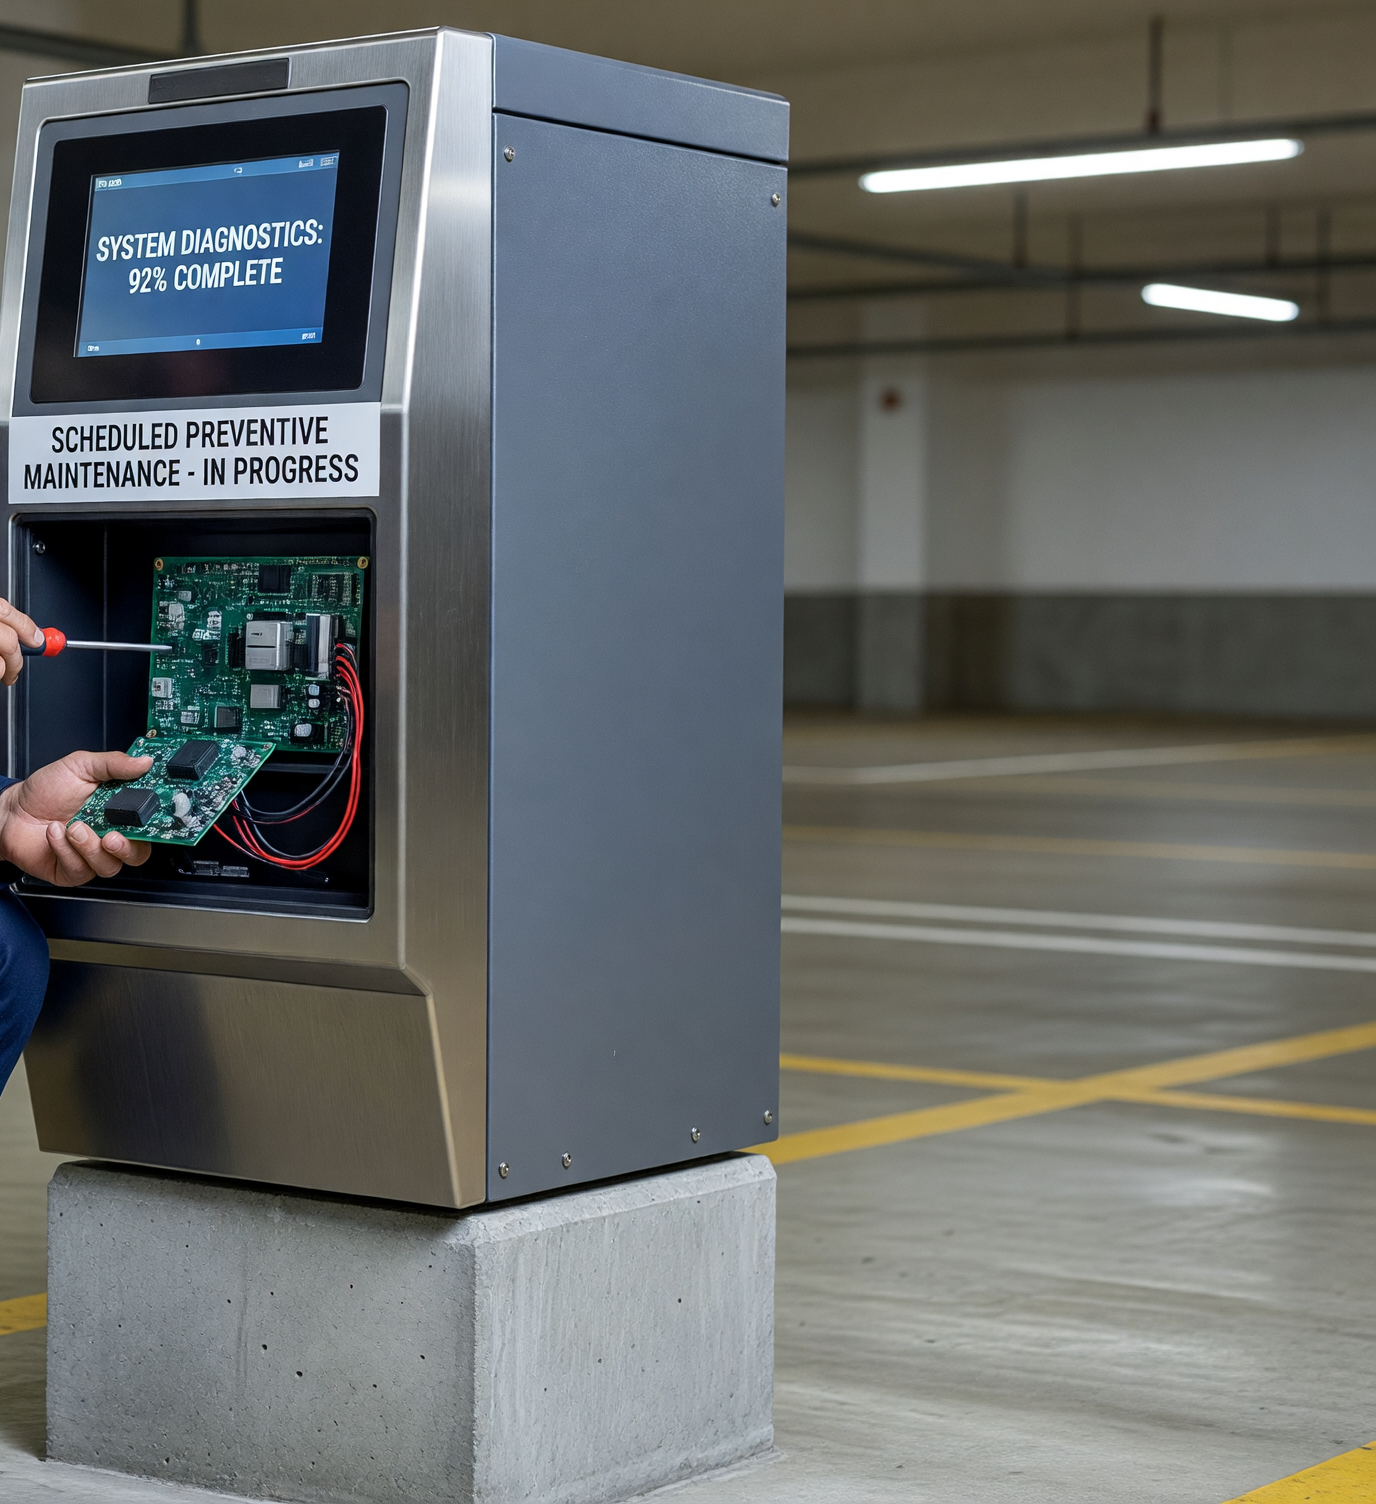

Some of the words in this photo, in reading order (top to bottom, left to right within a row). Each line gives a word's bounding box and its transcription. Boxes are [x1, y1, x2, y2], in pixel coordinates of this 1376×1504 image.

[96, 230, 176, 262] SYSTEM
[180, 218, 324, 255] DIAGNOSTICS:
[128, 266, 167, 294] 92%
[174, 257, 284, 291] COMPLETE
[51, 423, 178, 453] SCHEDULED
[185, 416, 329, 449] PREVENTIVE
[24, 459, 181, 490] MAINTENANCE
[203, 457, 226, 486] IN
[233, 453, 359, 485] PROGRESS
